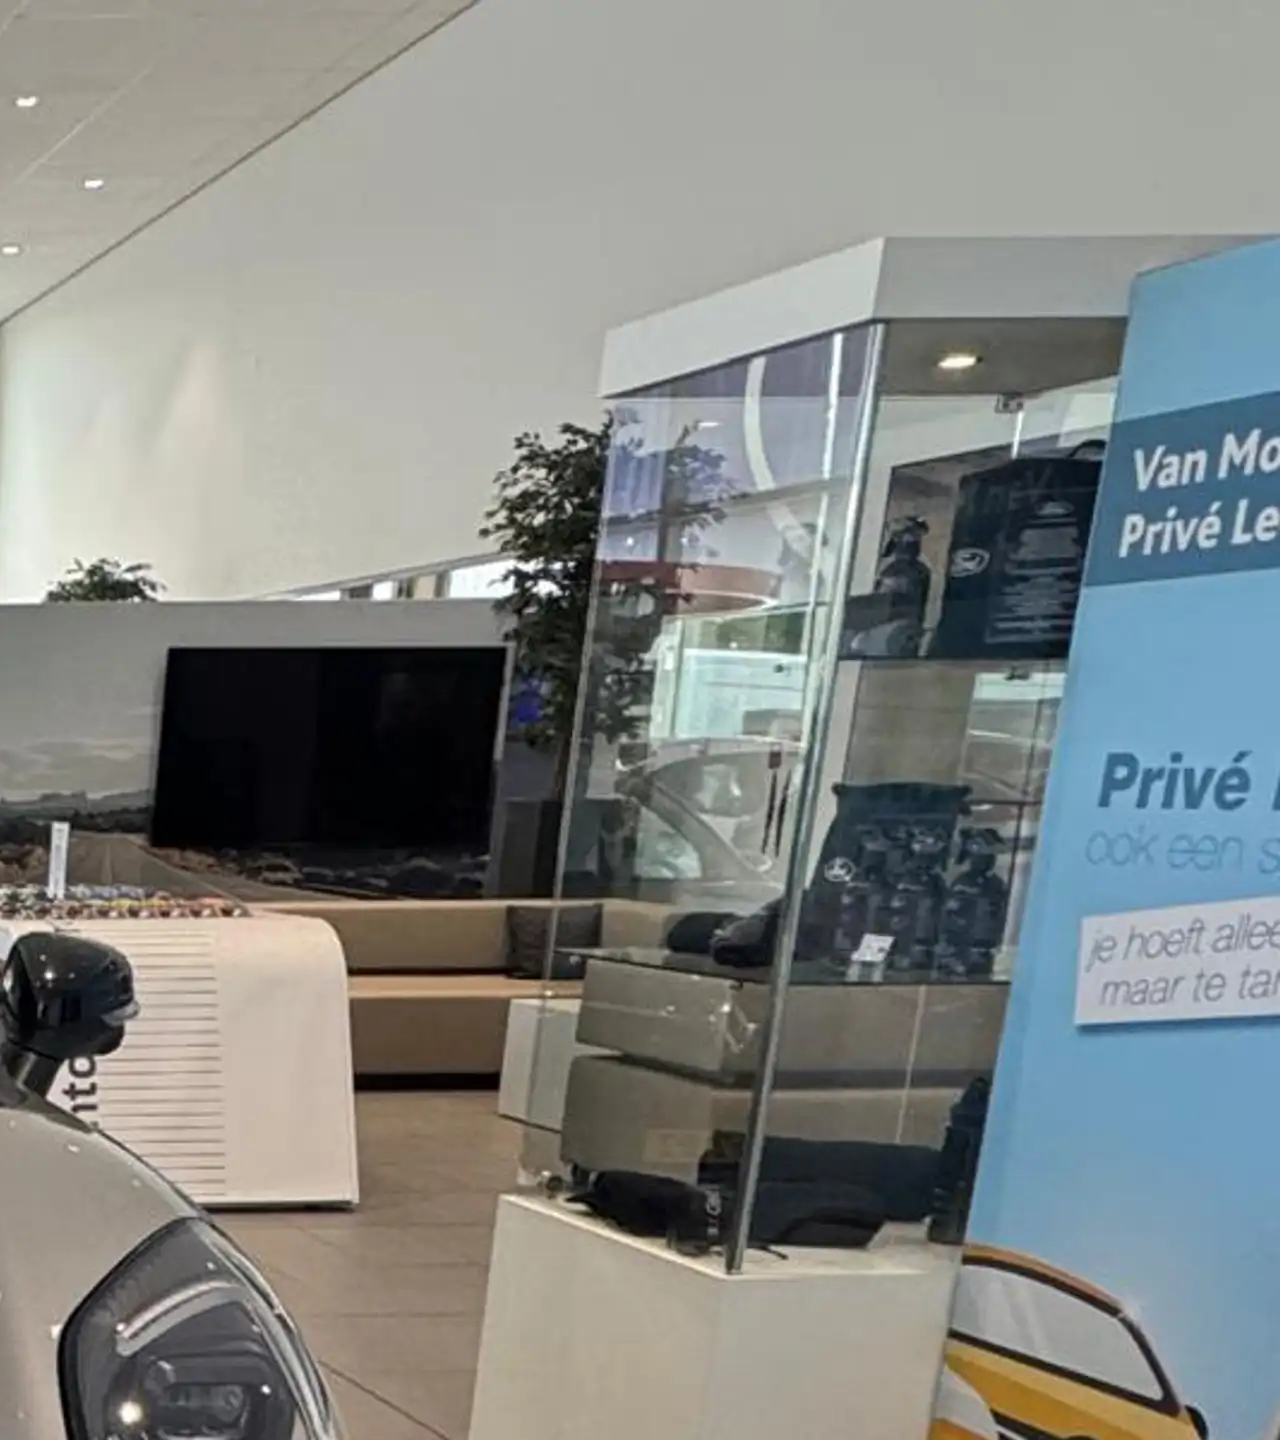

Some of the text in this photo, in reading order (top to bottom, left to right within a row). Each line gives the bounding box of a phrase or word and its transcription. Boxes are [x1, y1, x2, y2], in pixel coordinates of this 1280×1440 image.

[1134, 445, 1208, 491] Van
[1118, 501, 1223, 558] Privé
[1097, 751, 1253, 810] Privé
[1085, 824, 1160, 866] ook
[1166, 833, 1244, 872] een
[1085, 929, 1118, 973] je
[1122, 917, 1204, 960] hoeft
[1099, 976, 1186, 1006] maar
[1192, 968, 1226, 1002] te
